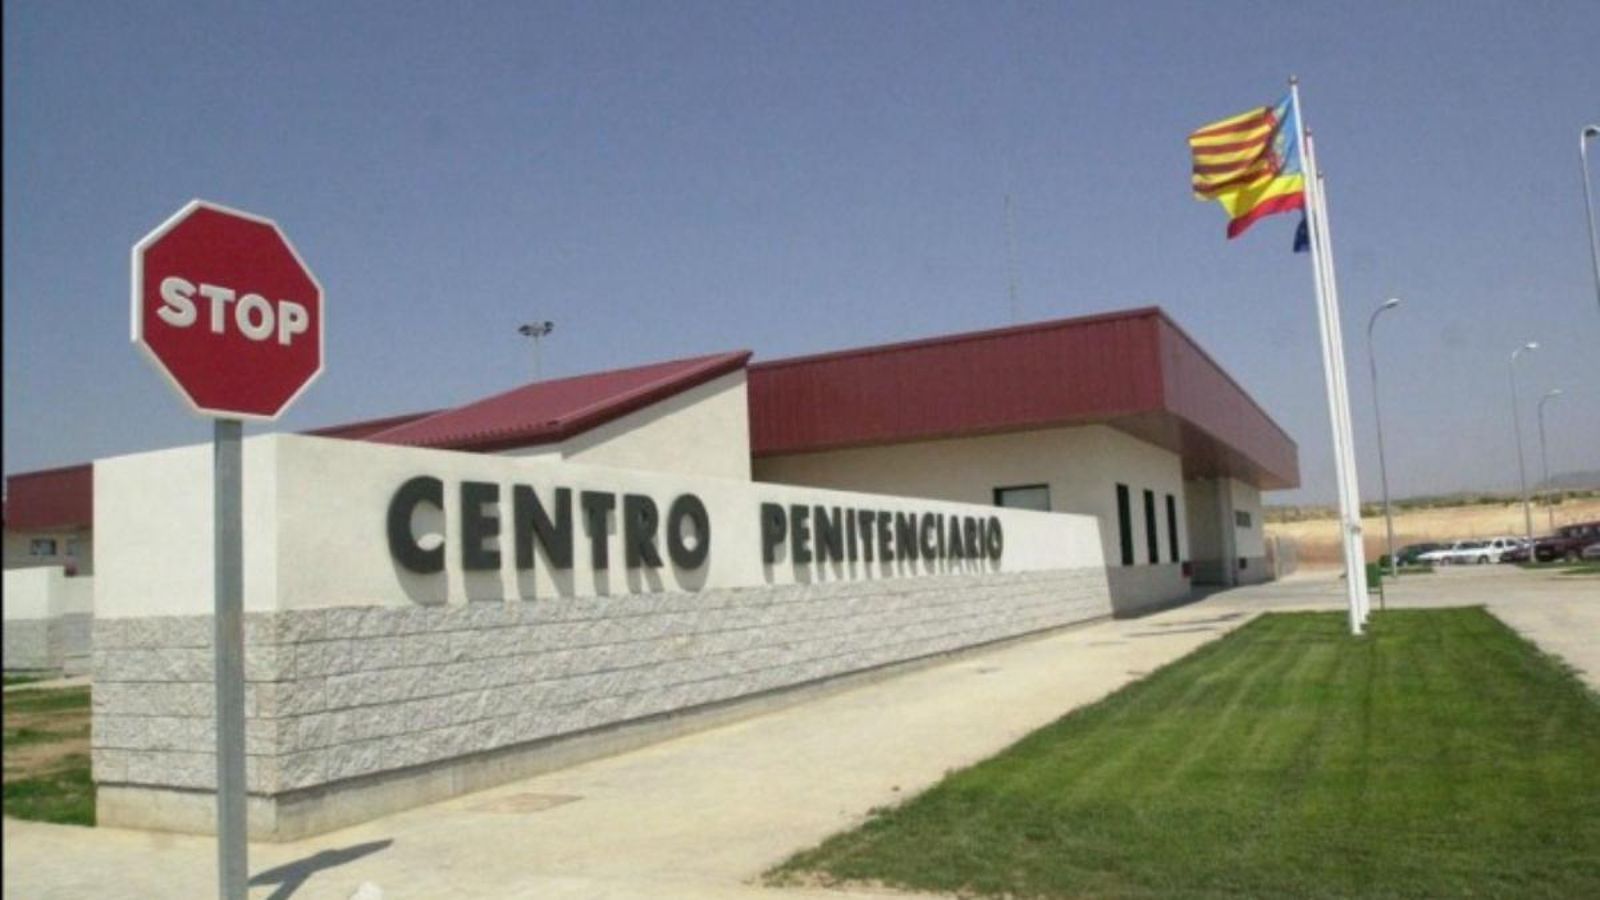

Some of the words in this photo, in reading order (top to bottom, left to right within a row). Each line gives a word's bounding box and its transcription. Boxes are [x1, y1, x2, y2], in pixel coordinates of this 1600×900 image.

[156, 276, 309, 346] STOP
[387, 475, 710, 574] CENTRO
[760, 502, 1004, 564] PENITENCIARIO
